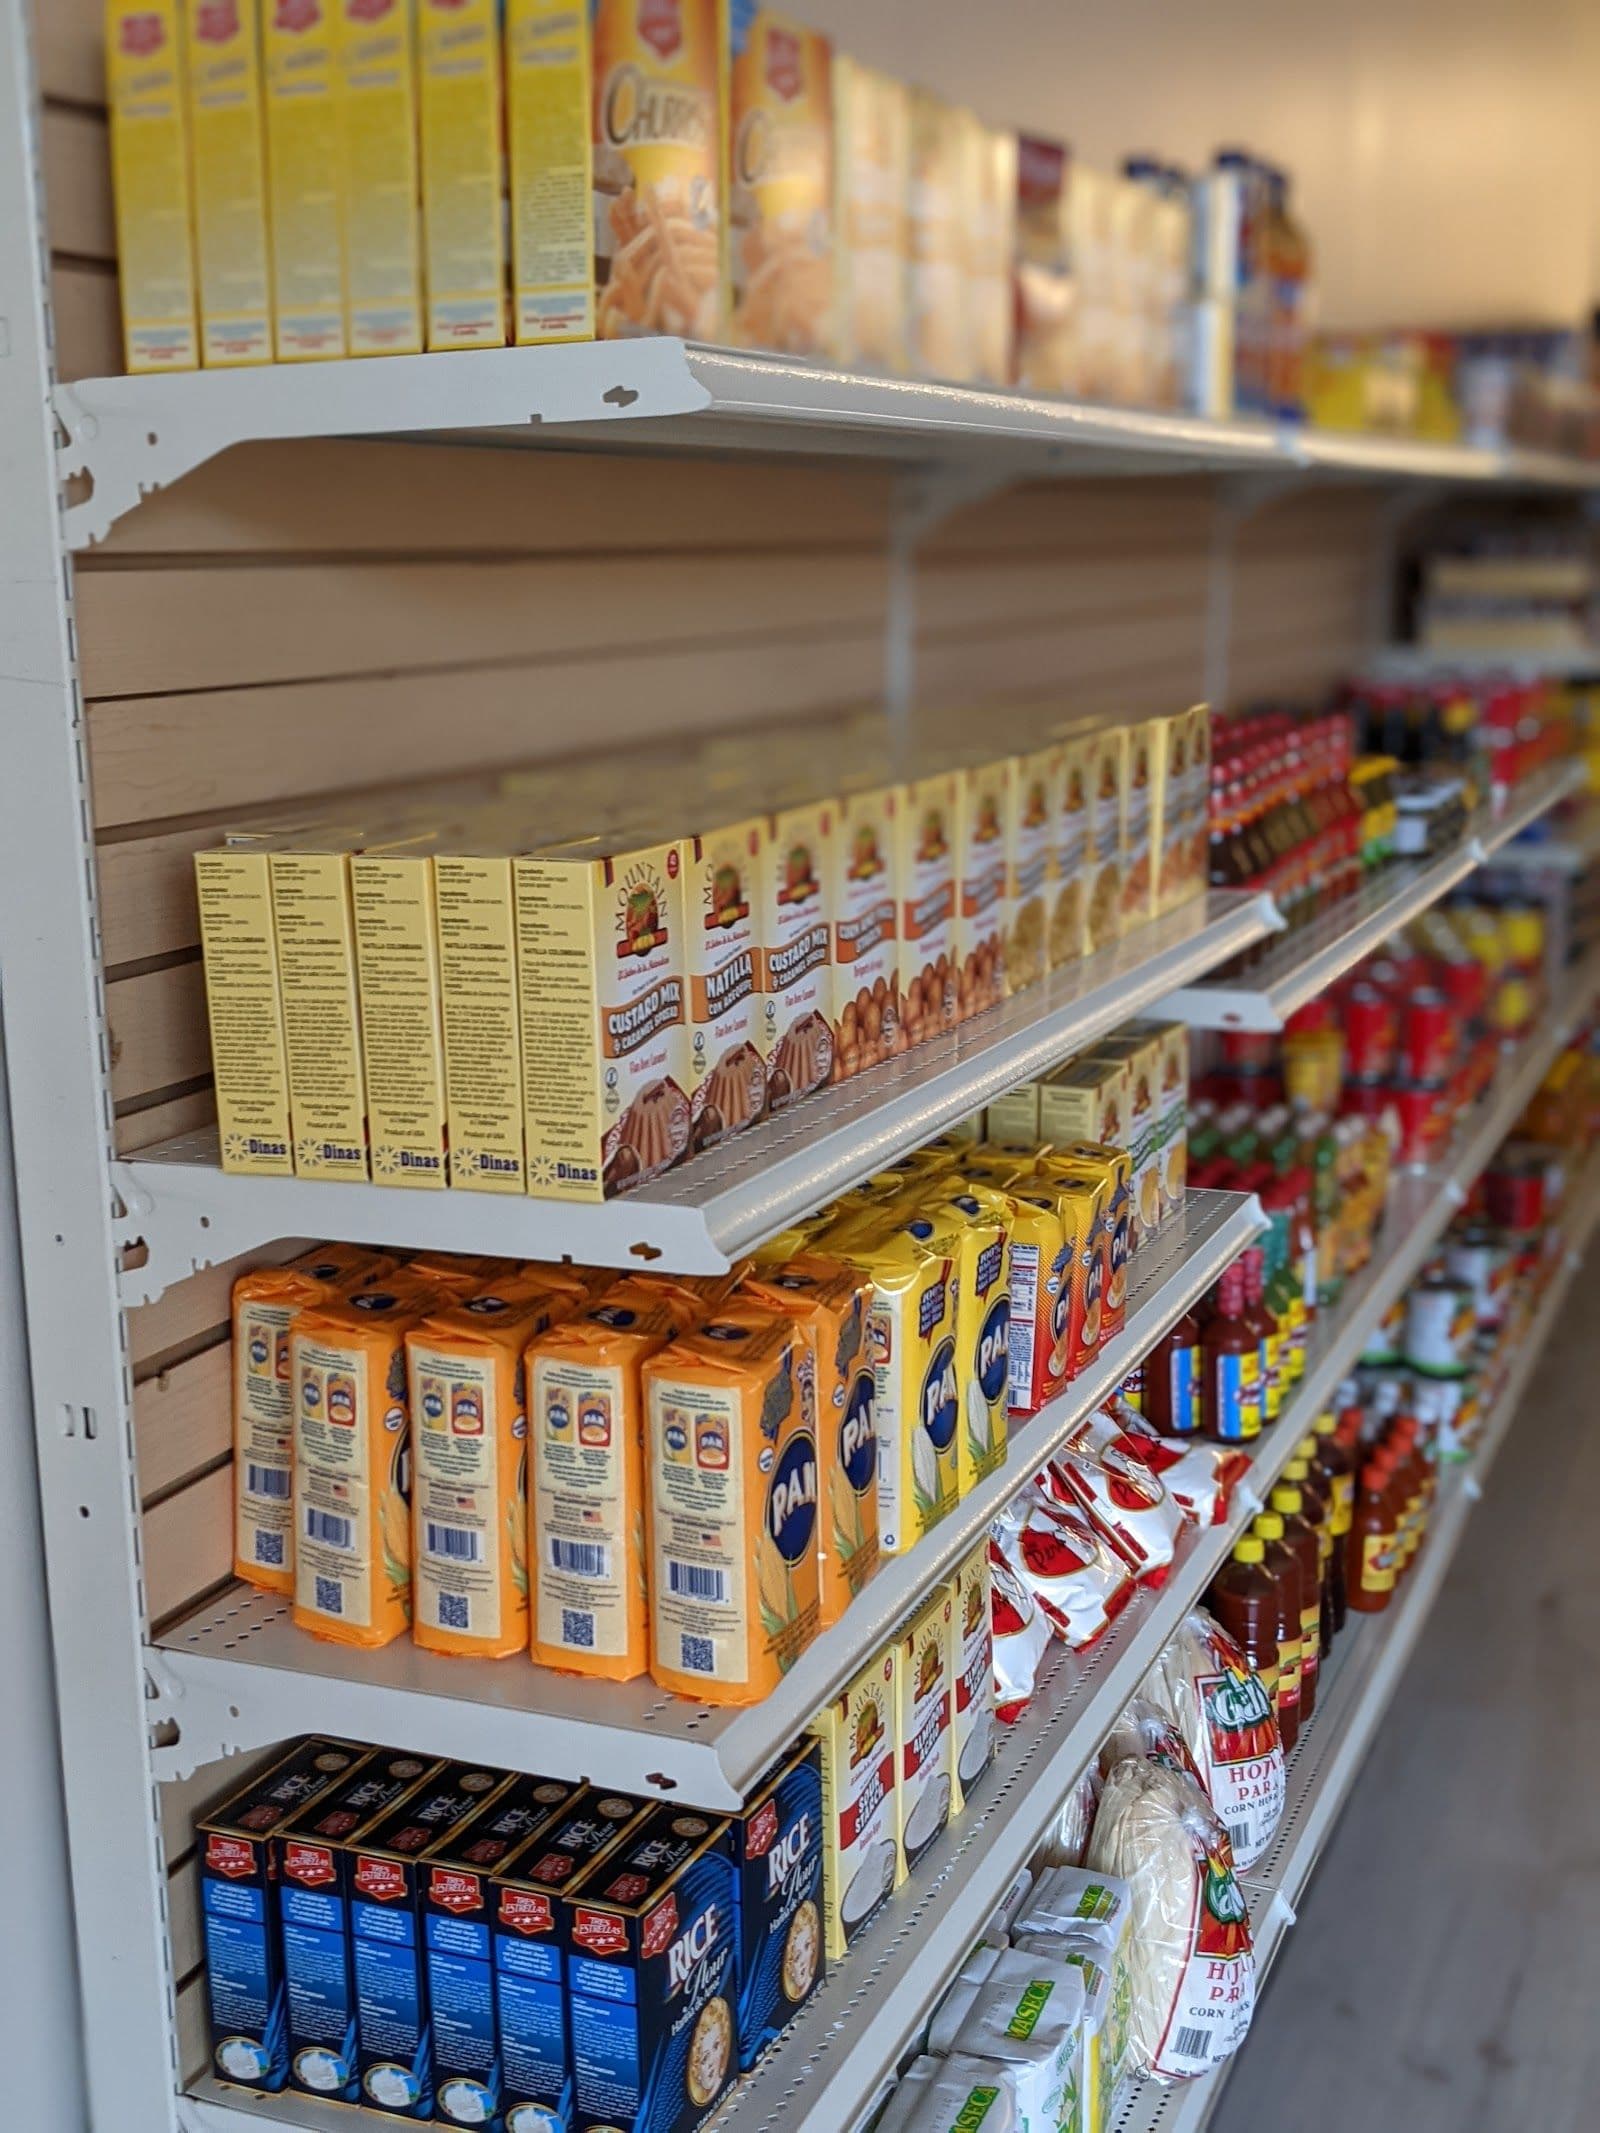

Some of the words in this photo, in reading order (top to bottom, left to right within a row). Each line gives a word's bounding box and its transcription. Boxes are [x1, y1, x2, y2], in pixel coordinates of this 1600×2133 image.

[770, 934, 811, 972] CUSTARD
[812, 927, 828, 946] MIX
[706, 952, 752, 998] NATILLA
[608, 992, 659, 1034] CUSTARD
[661, 982, 680, 1004] MIX
[249, 1138, 287, 1155] Dinas
[322, 1143, 362, 1160] Dinas
[400, 1150, 440, 1168] Dinas
[480, 1153, 520, 1172] Dinas
[557, 1162, 598, 1182] Dinas
[1224, 1802, 1255, 1815] CORN
[558, 1819, 596, 1848] RICE
[632, 1839, 671, 1868] RICE
[768, 1812, 810, 1888] RICE
[436, 1882, 476, 1894] ESTRELLAS
[505, 1903, 546, 1915] ESTRELLAS
[580, 1924, 621, 1936] ESTRELLAS
[668, 1902, 718, 1988] RICE
[1004, 1979, 1054, 2041] MASECA
[1189, 2006, 1226, 2019] CORN
